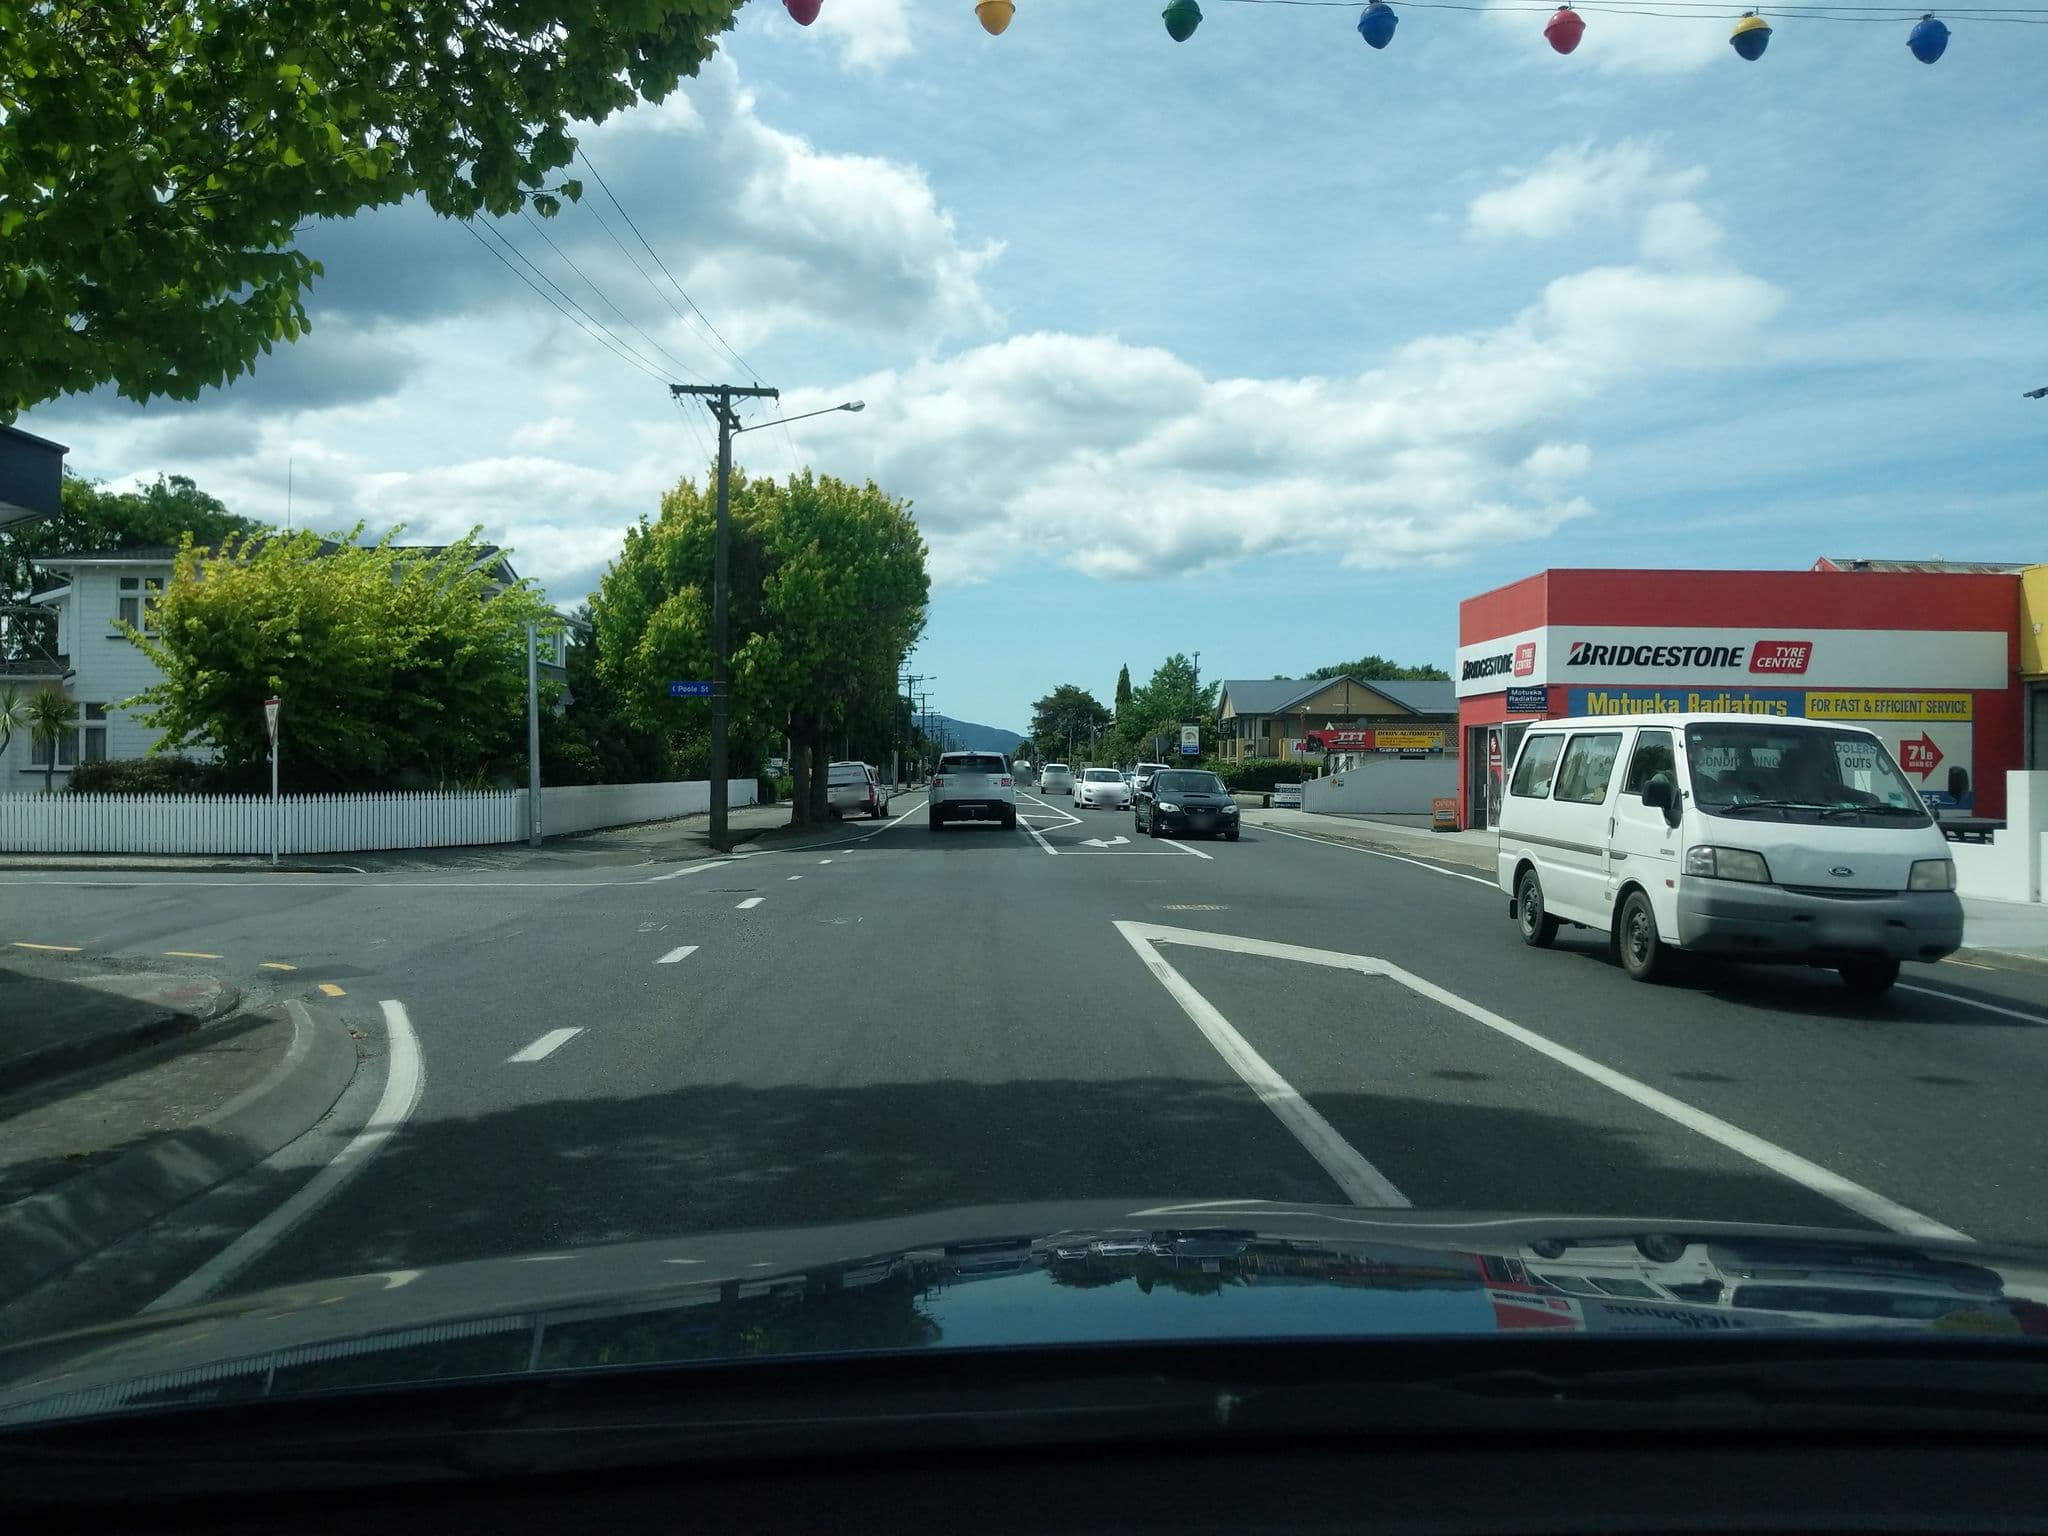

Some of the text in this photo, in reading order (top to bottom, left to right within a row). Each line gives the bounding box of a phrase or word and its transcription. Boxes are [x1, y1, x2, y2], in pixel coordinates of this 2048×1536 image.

[1567, 642, 1745, 667] BRIDGESTONE
[1776, 647, 1807, 658] TYRE
[1462, 653, 1514, 681] BRIDGESTONE
[1757, 657, 1804, 669] CENTRE
[1509, 695, 1546, 703] Radiators
[1587, 692, 1788, 716] Motueka Radiators
[1811, 698, 1967, 714] FOR FAST & EFFICIENT SERVICE
[1844, 757, 1872, 769] OUTS
